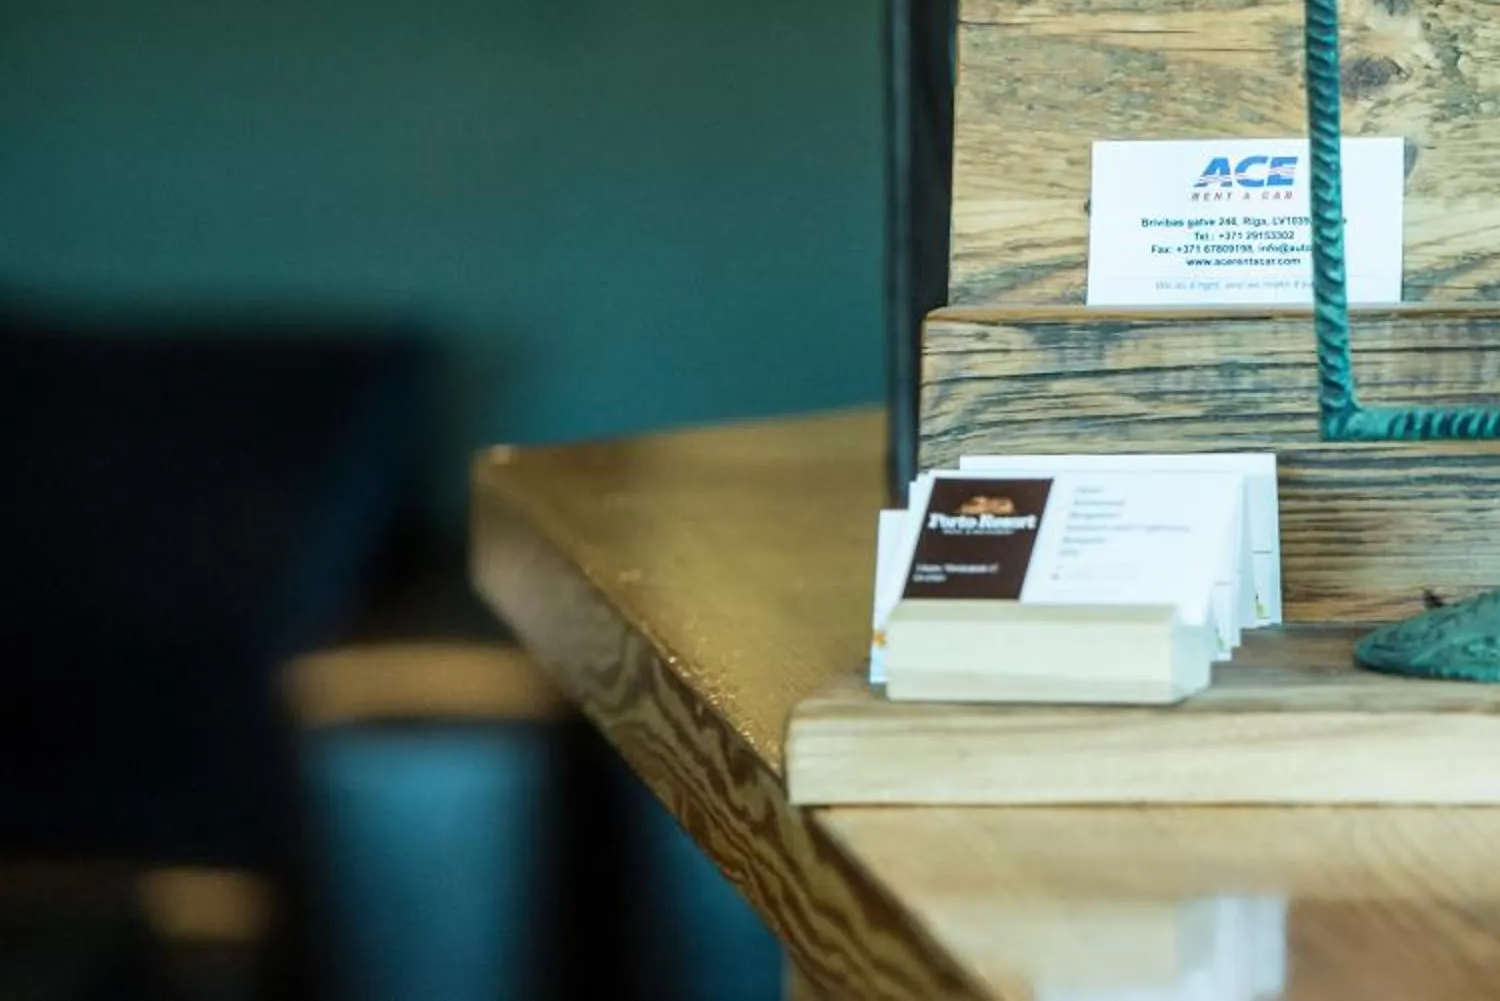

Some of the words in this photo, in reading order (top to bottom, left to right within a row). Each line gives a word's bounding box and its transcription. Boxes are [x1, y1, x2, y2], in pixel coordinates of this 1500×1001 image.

[1193, 156, 1298, 187] ACE
[1191, 191, 1233, 201] RENT
[1243, 192, 1250, 200] A
[1262, 191, 1294, 200] CAR
[1219, 230, 1243, 241] +371
[1176, 244, 1201, 255] +371
